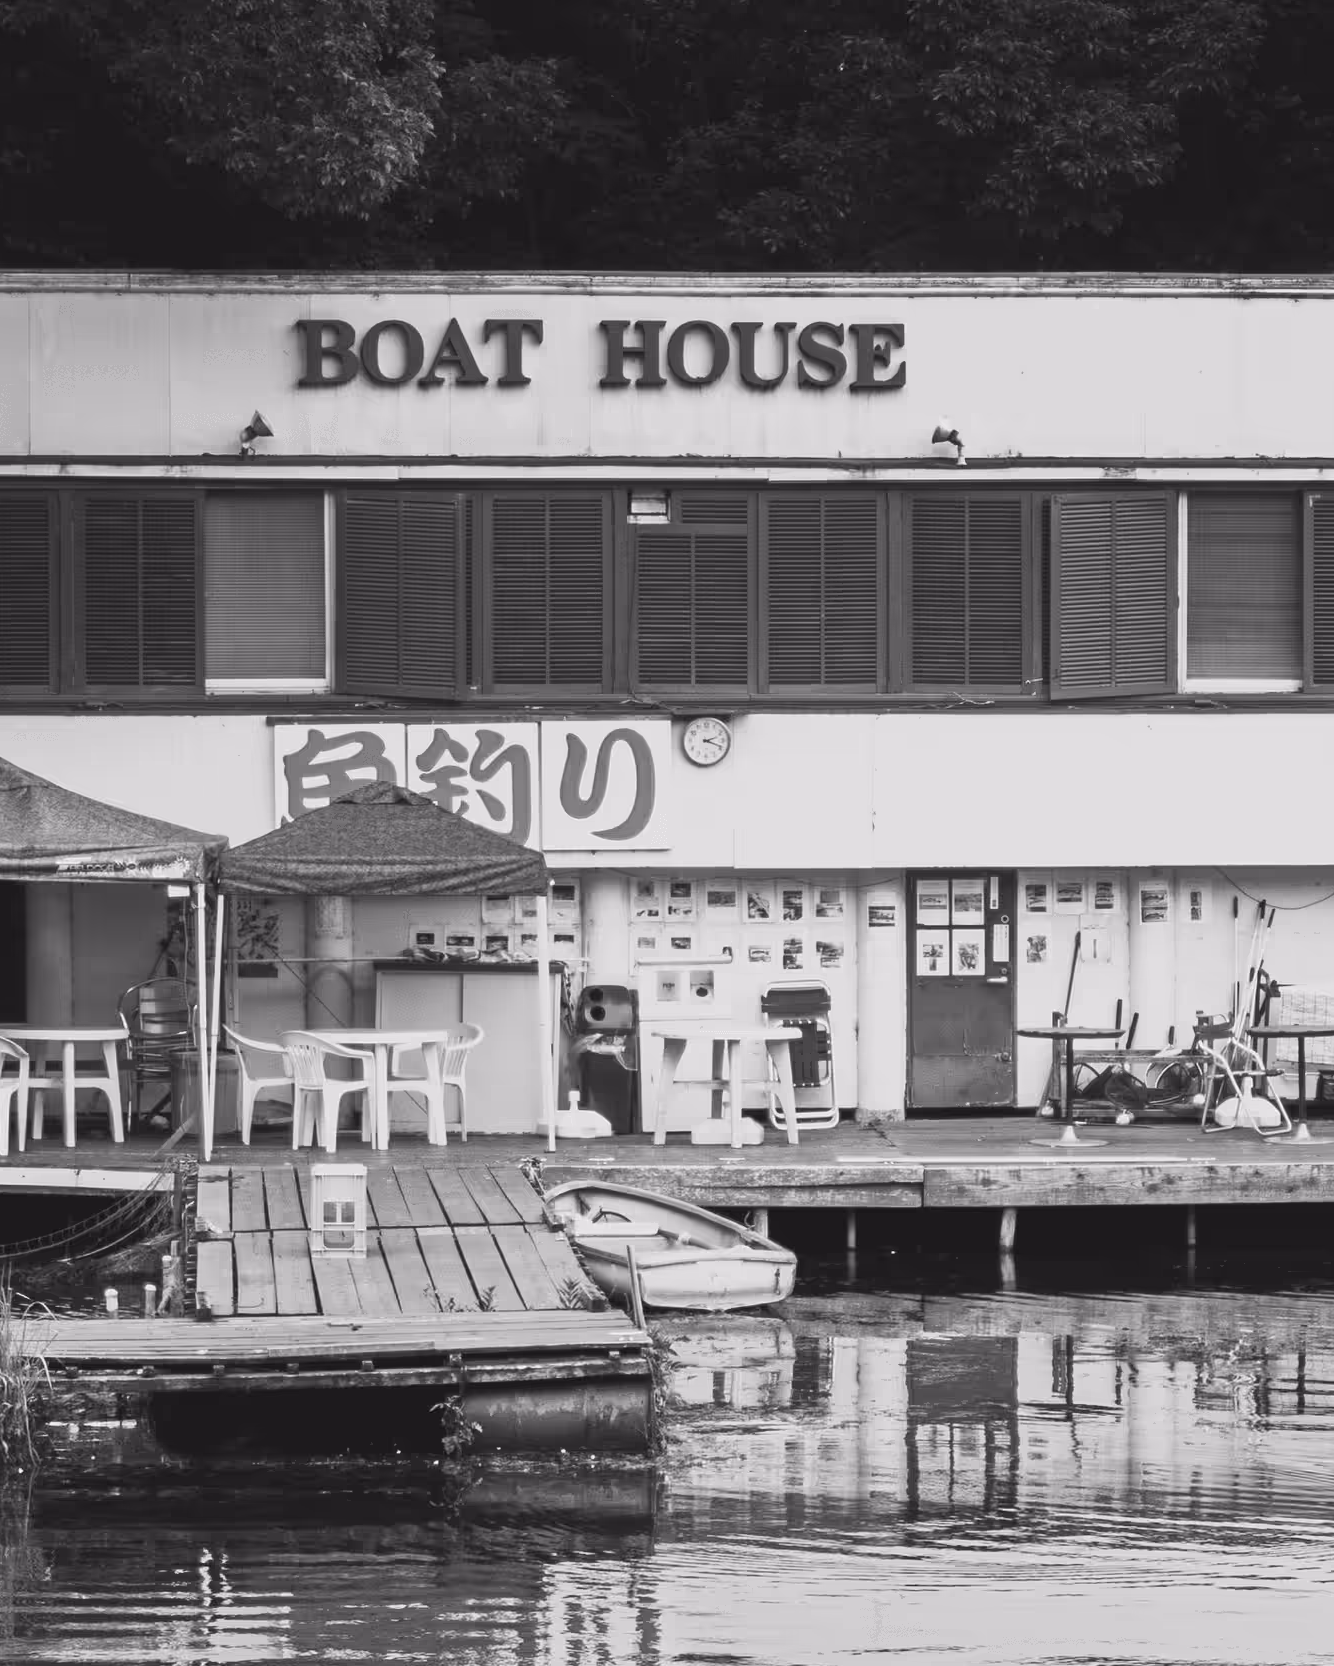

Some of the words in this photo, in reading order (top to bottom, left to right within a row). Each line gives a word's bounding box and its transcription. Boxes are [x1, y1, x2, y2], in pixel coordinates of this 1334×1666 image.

[296, 318, 544, 387] BOAT
[598, 319, 908, 391] HOUSE
[281, 728, 656, 846] 魚釣り
